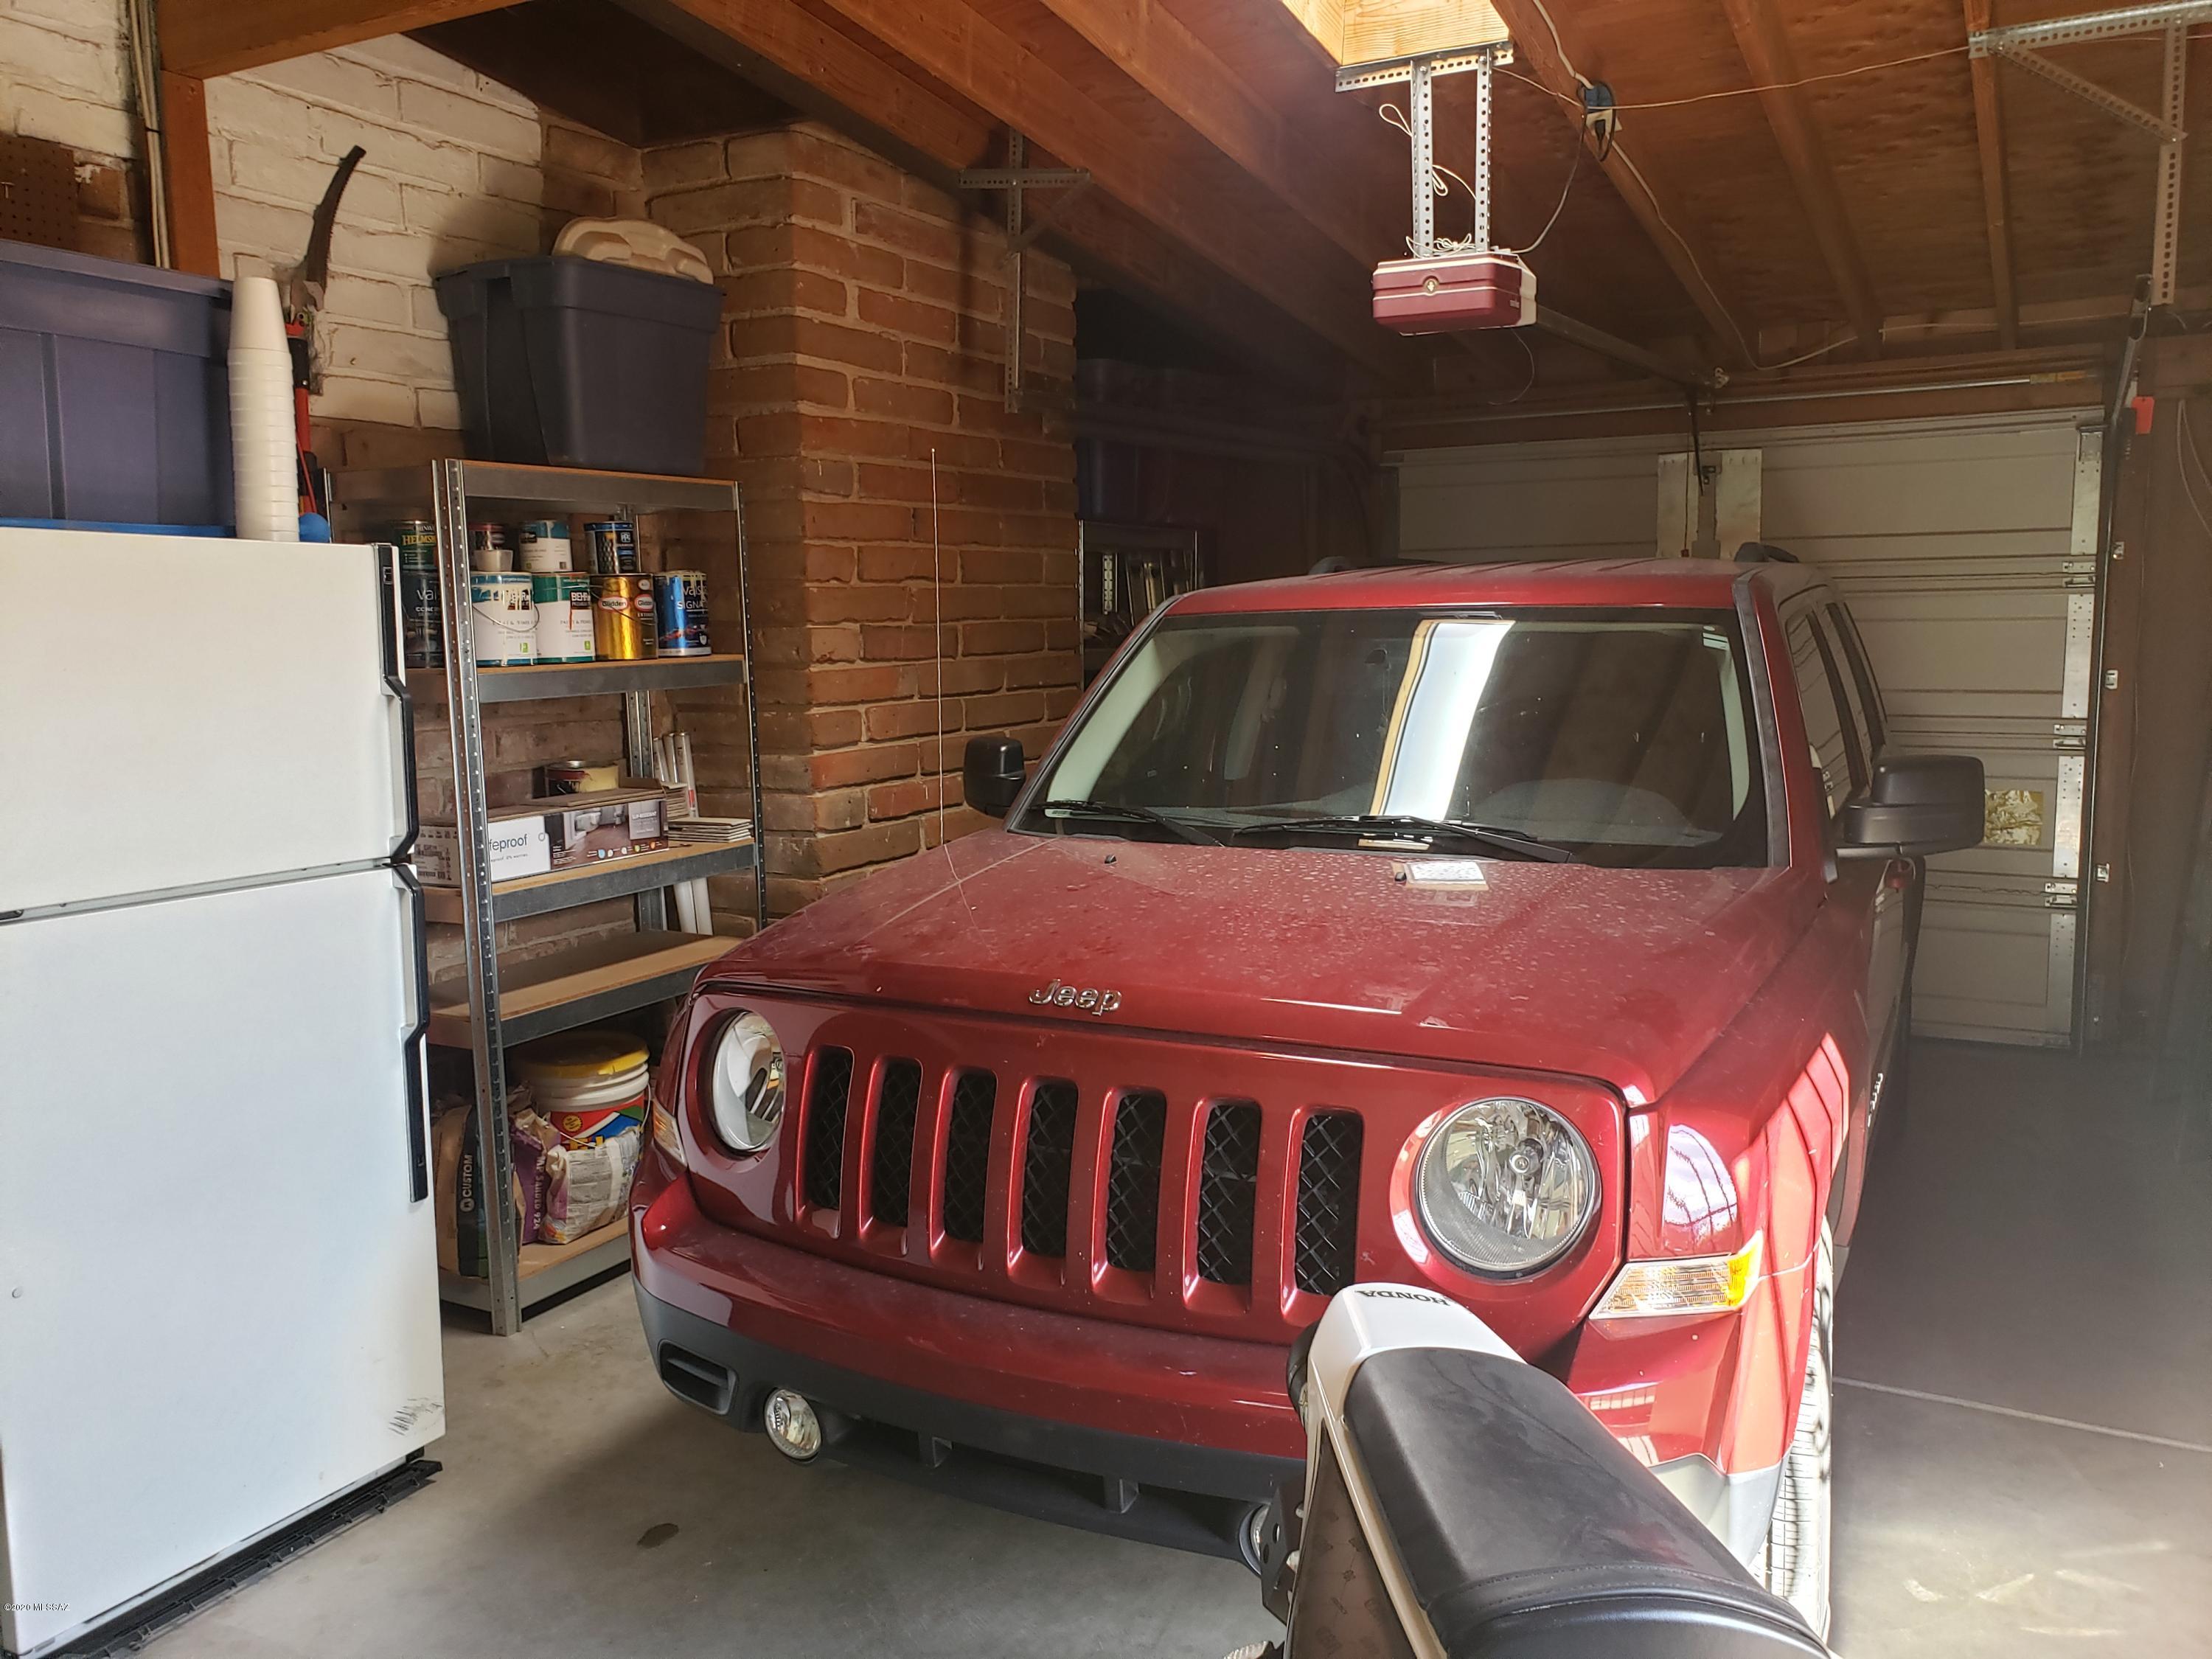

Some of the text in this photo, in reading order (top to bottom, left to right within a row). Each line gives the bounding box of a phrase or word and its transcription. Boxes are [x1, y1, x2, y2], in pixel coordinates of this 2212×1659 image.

[1029, 978, 1122, 1016] Jeep
[462, 1155, 473, 1197] CUSTOM
[1355, 1290, 1450, 1306] HONDA
